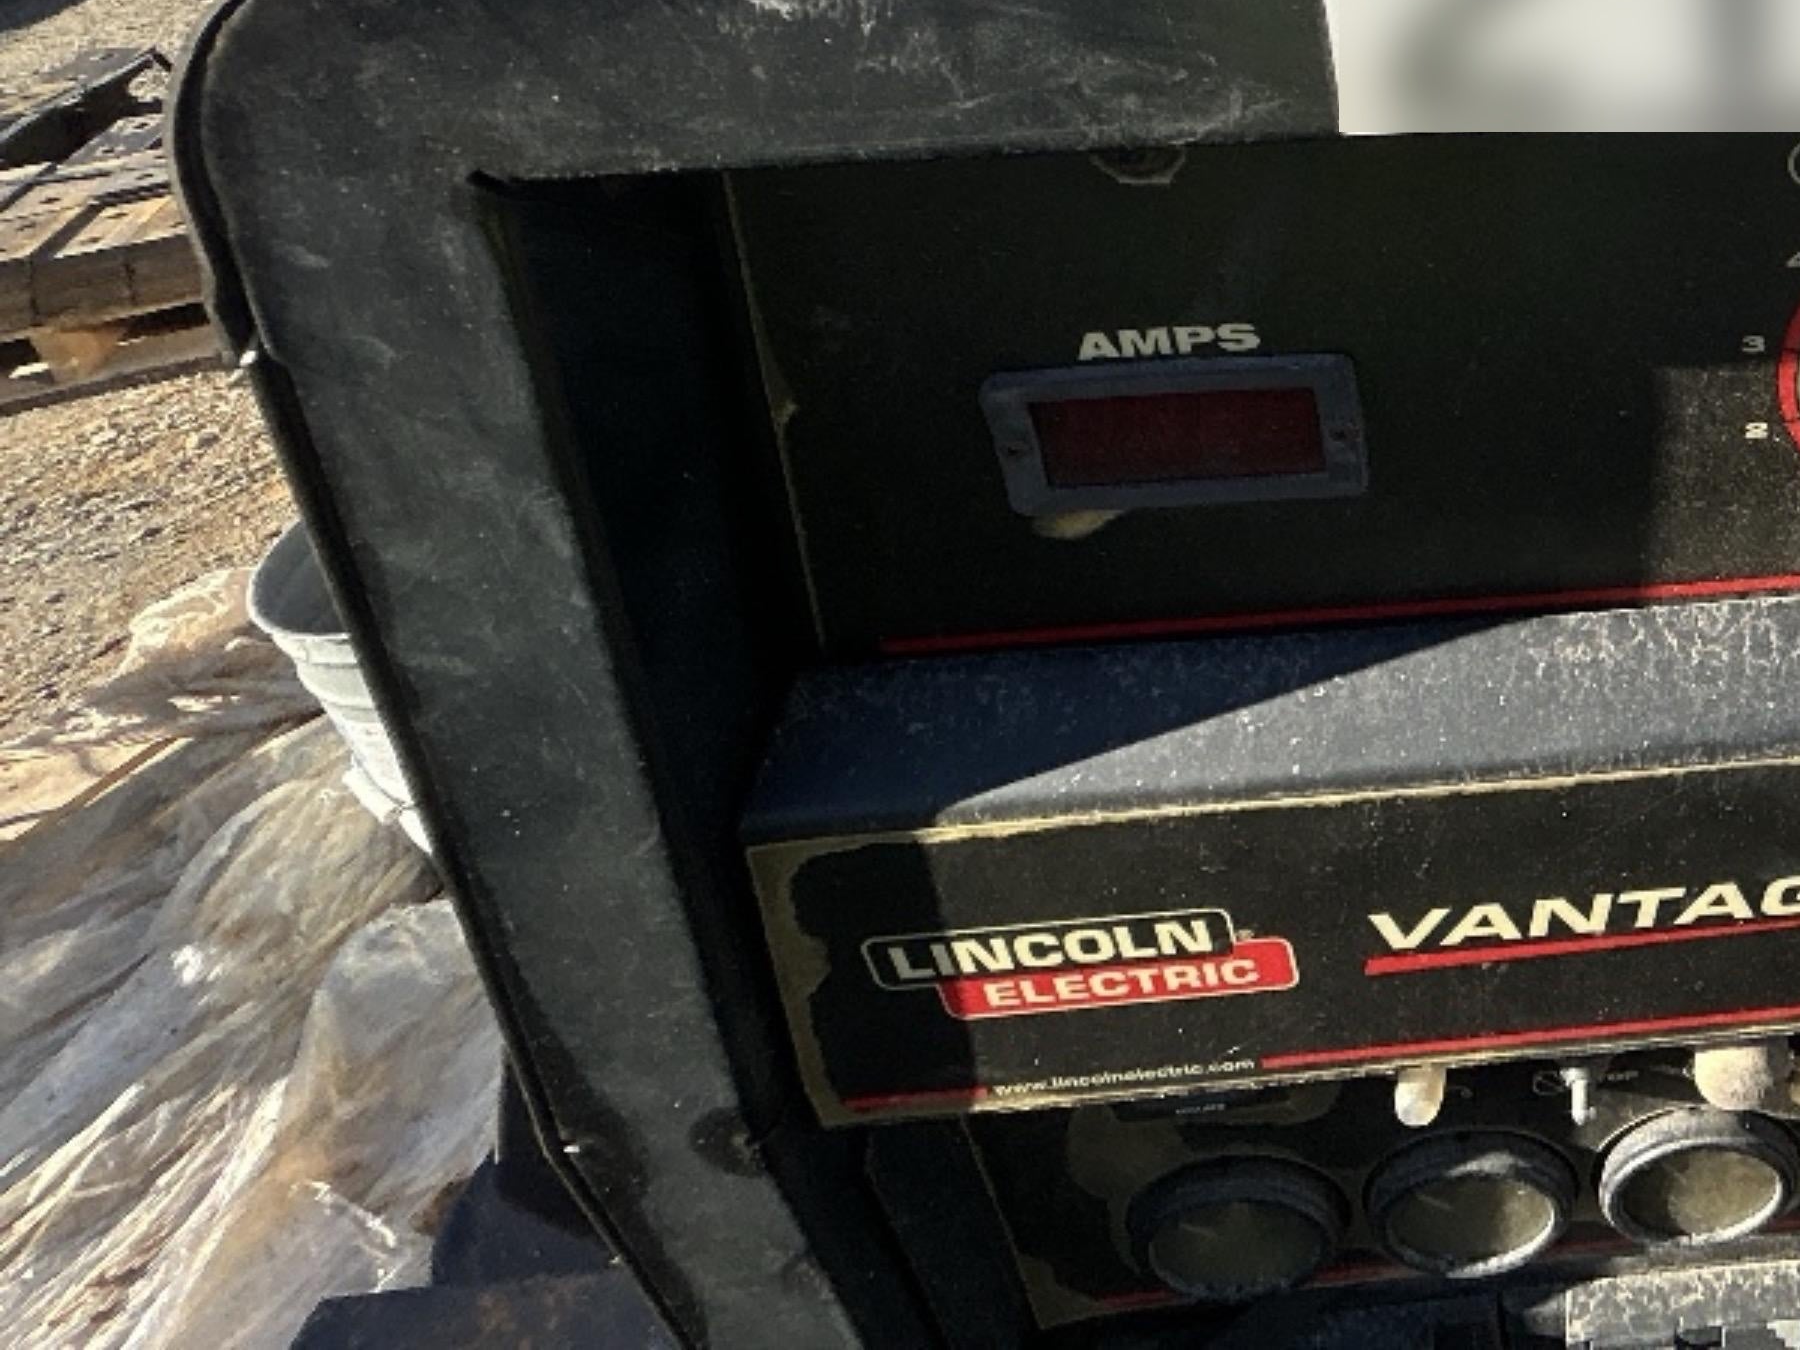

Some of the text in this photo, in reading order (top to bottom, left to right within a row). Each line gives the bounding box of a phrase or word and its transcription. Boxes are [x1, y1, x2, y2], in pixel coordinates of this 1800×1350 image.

[1078, 323, 1261, 360] AMPS
[1742, 335, 1766, 353] 3
[1744, 422, 1769, 440] 2
[887, 919, 1214, 979] LINCOLN
[983, 958, 1260, 1008] ELECTRIC
